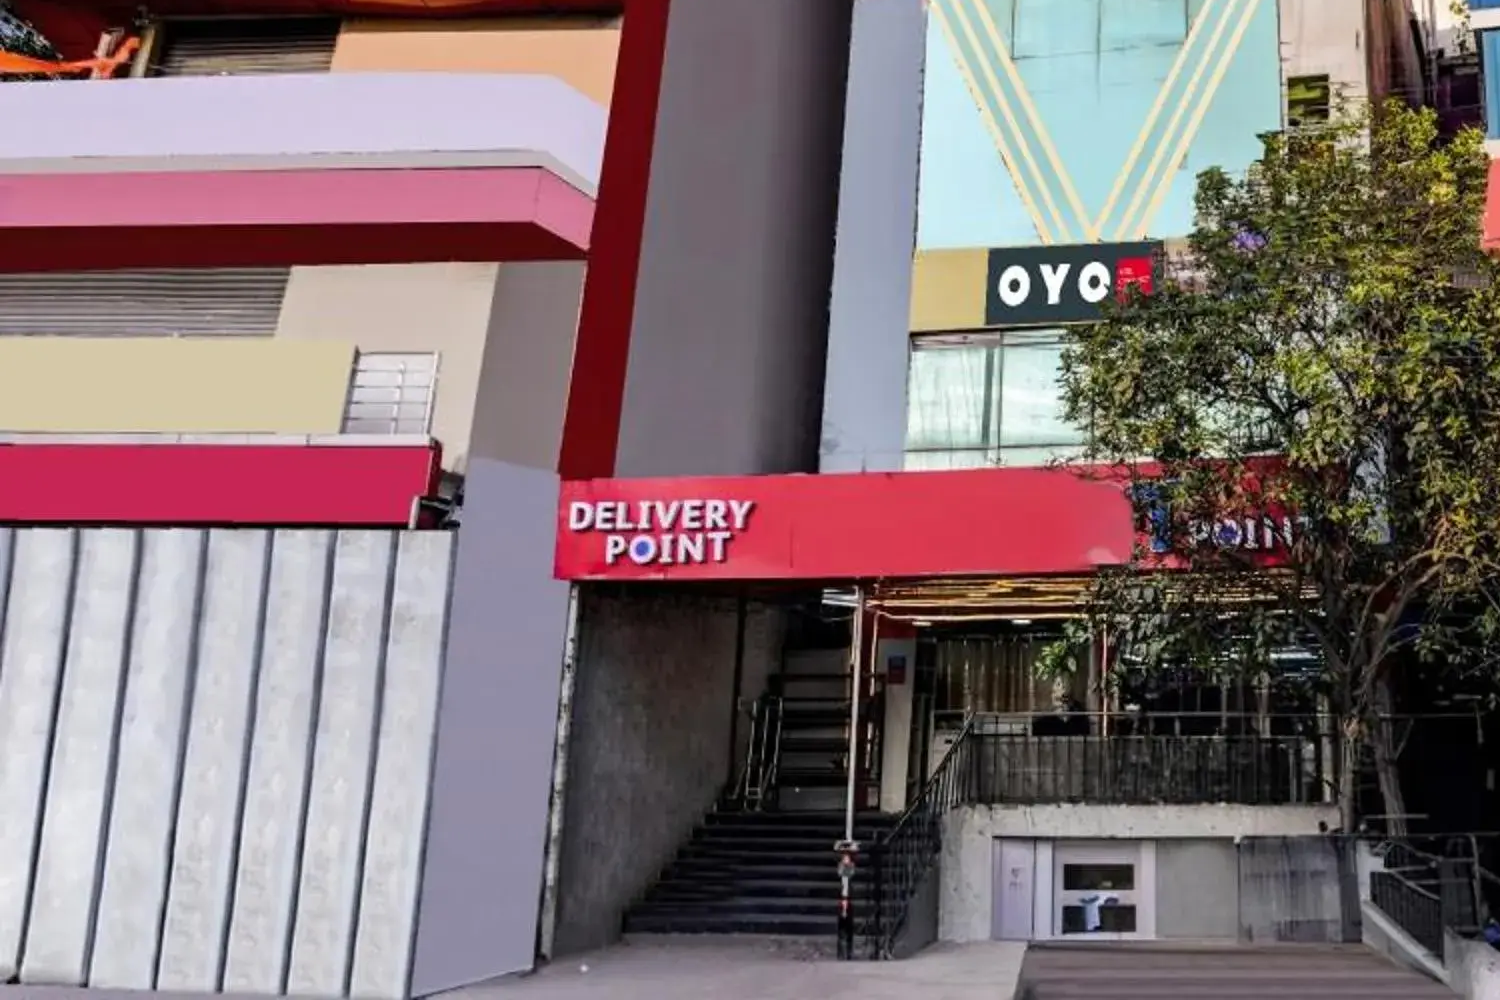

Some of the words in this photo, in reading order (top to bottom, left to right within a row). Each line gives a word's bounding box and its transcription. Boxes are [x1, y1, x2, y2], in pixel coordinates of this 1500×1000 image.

[998, 261, 1111, 307] OYO
[569, 499, 753, 530] DELIVERY
[605, 531, 732, 565] POINT
